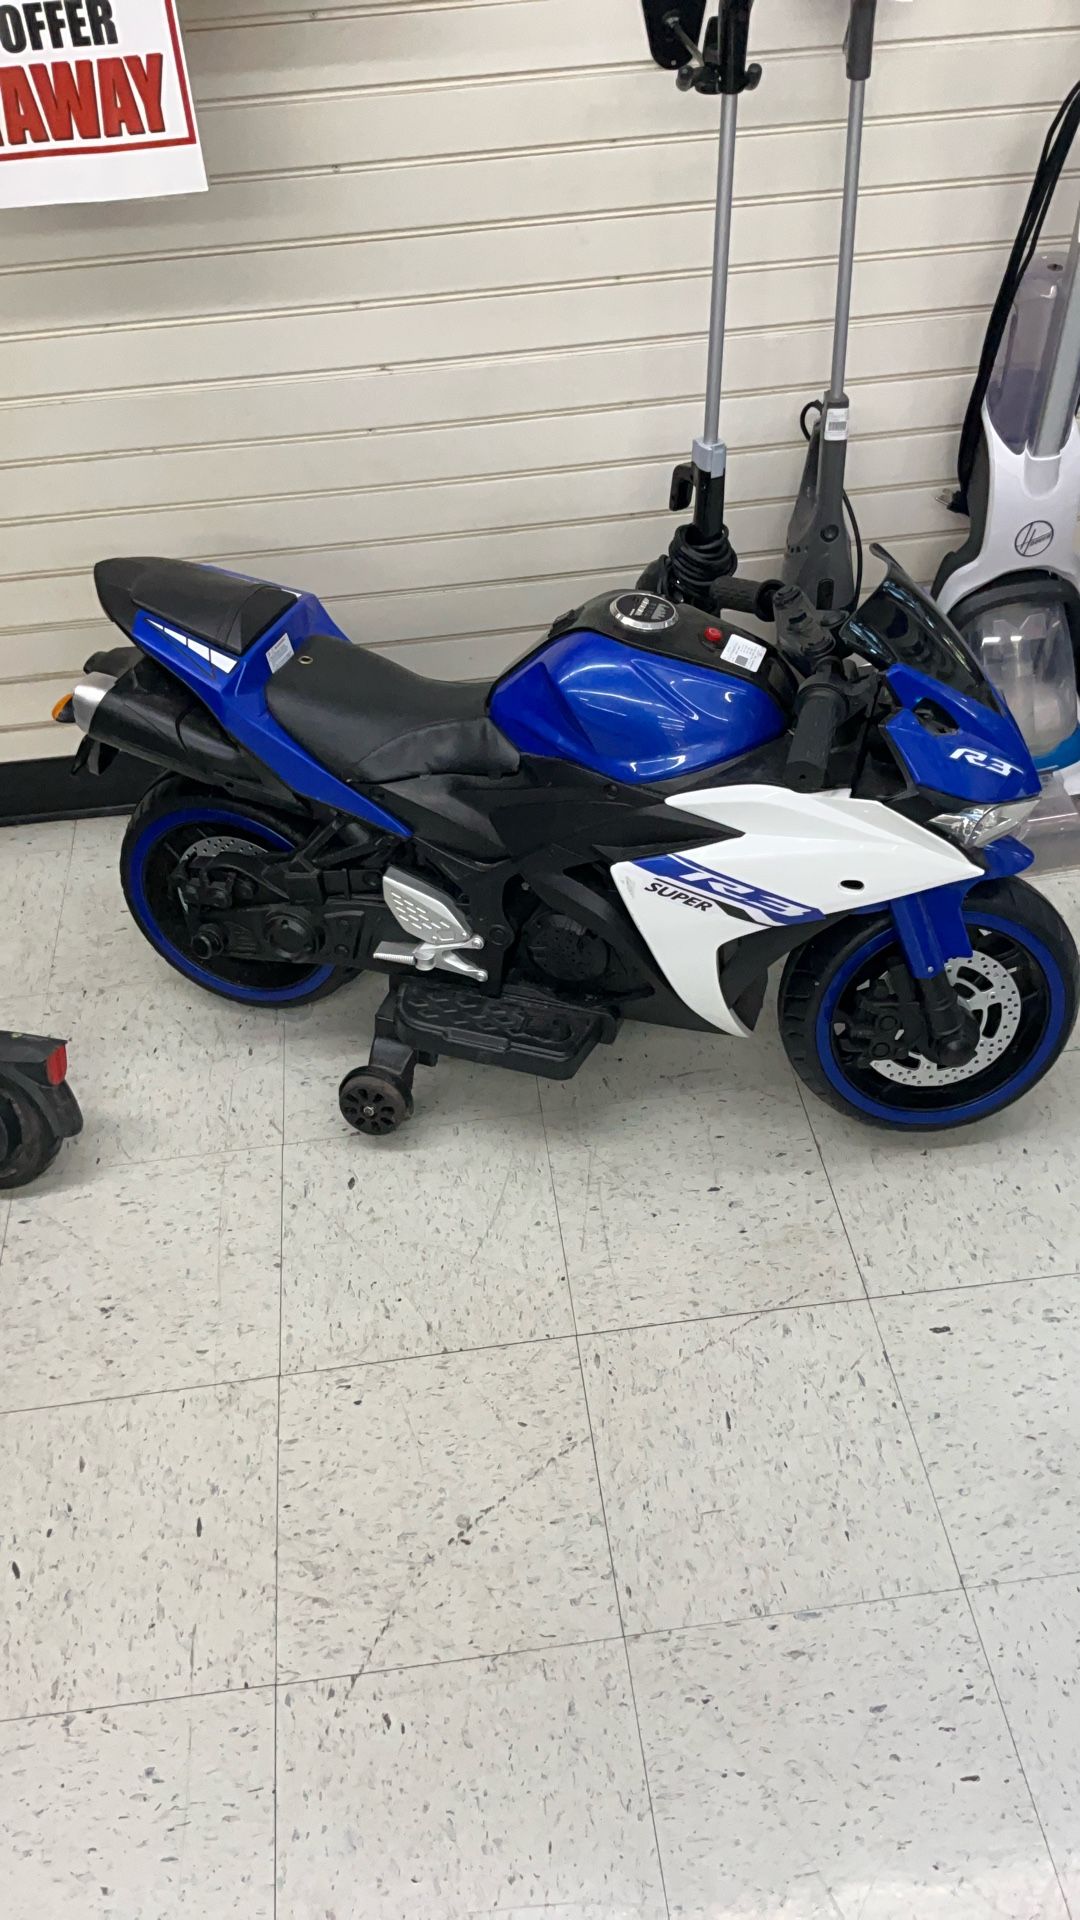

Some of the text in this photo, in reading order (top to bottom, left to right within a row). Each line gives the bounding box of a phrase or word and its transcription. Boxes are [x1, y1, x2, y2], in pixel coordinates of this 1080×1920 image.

[0, 0, 119, 53] OFFER
[0, 53, 165, 146] AWAY
[949, 748, 1024, 777] R3
[644, 882, 713, 912] SUPER
[679, 872, 812, 917] R3
